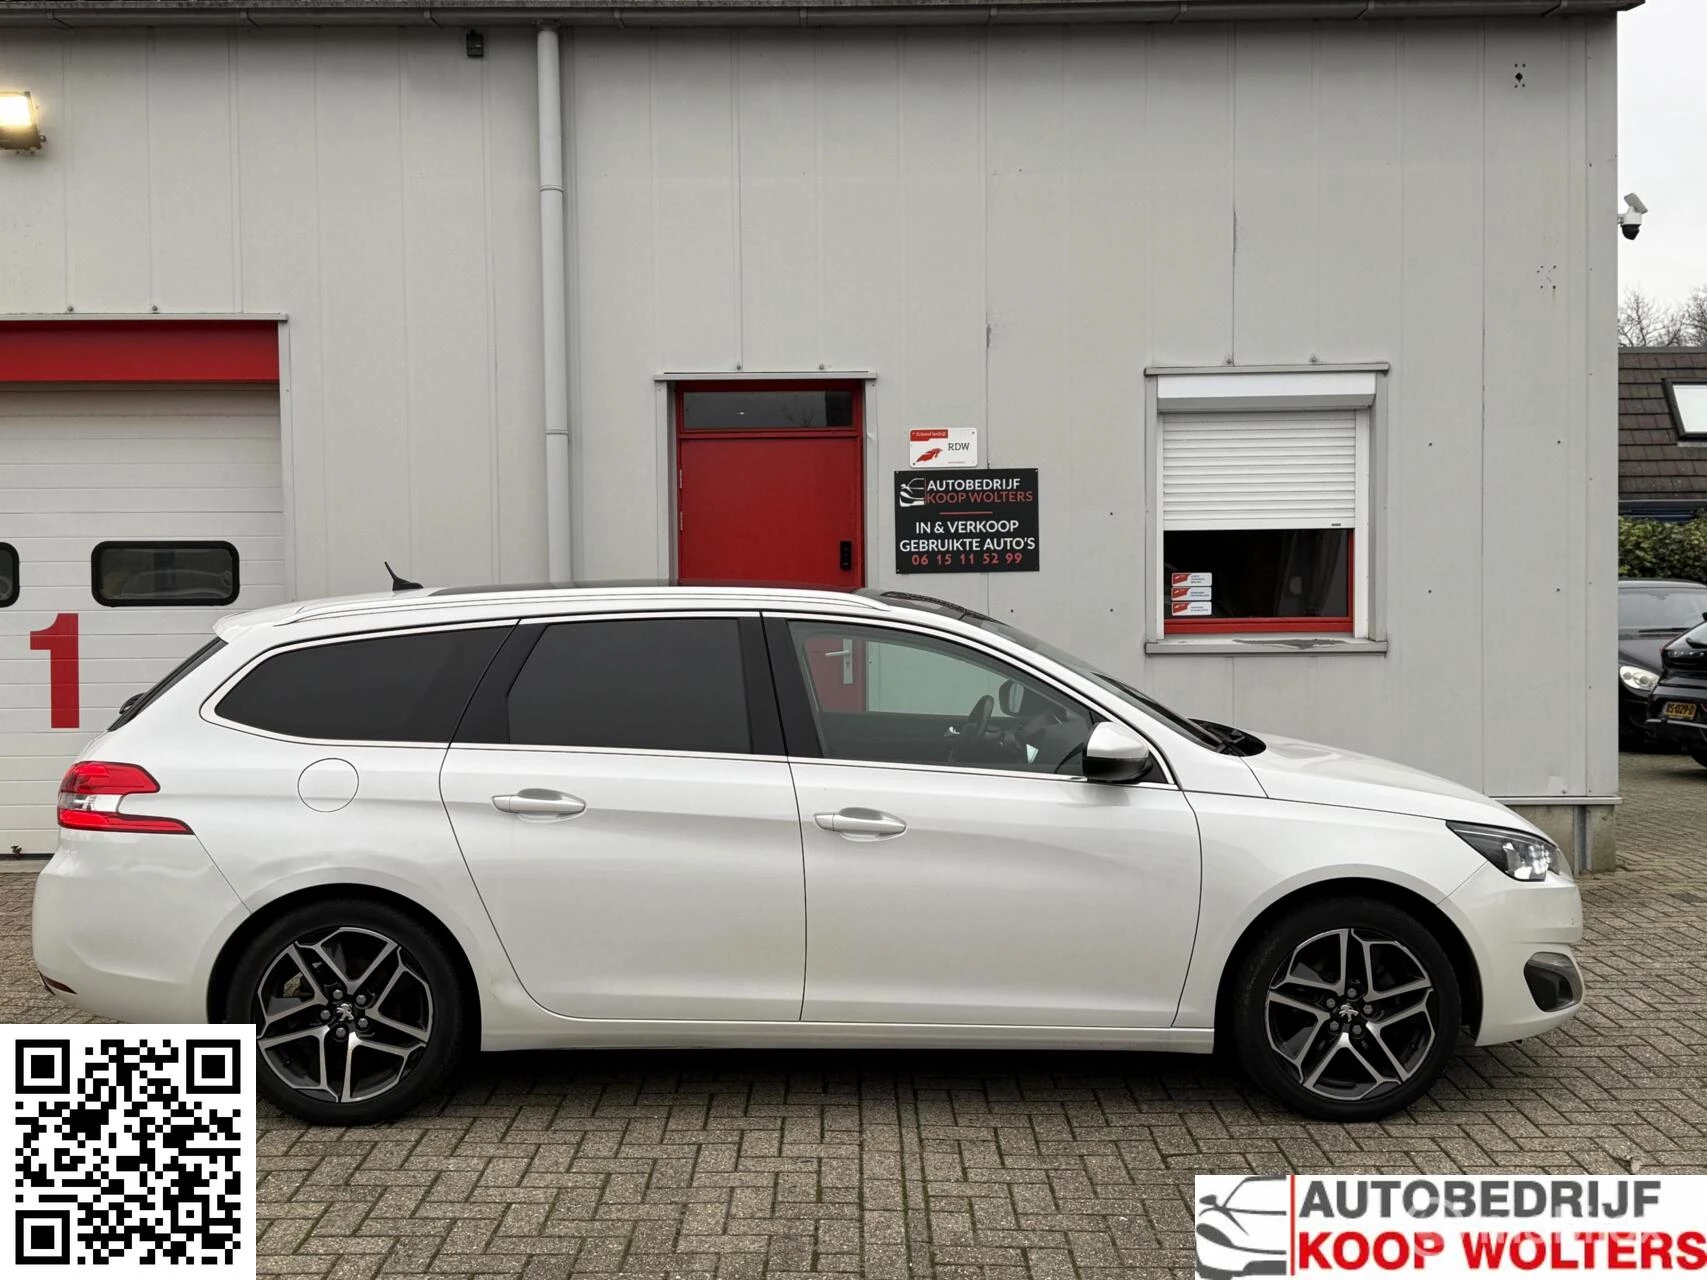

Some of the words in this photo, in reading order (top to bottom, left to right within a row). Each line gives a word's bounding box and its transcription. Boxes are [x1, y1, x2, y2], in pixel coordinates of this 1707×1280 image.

[948, 442, 970, 451] RDW
[927, 478, 1021, 491] AUTOBEDRIJF
[926, 492, 967, 504] KOOP
[968, 490, 1033, 503] WOLTERS
[915, 521, 931, 534] IN
[934, 521, 945, 534] &
[947, 520, 1019, 533] VERKOOP
[899, 538, 981, 552] GEBRUIKTE
[983, 537, 1036, 551] AUTO'S
[911, 554, 929, 566] 06
[936, 554, 952, 565] 15
[959, 553, 975, 565] 11
[982, 553, 999, 564] 52
[1005, 552, 1022, 564] 99
[30, 613, 80, 728] 1
